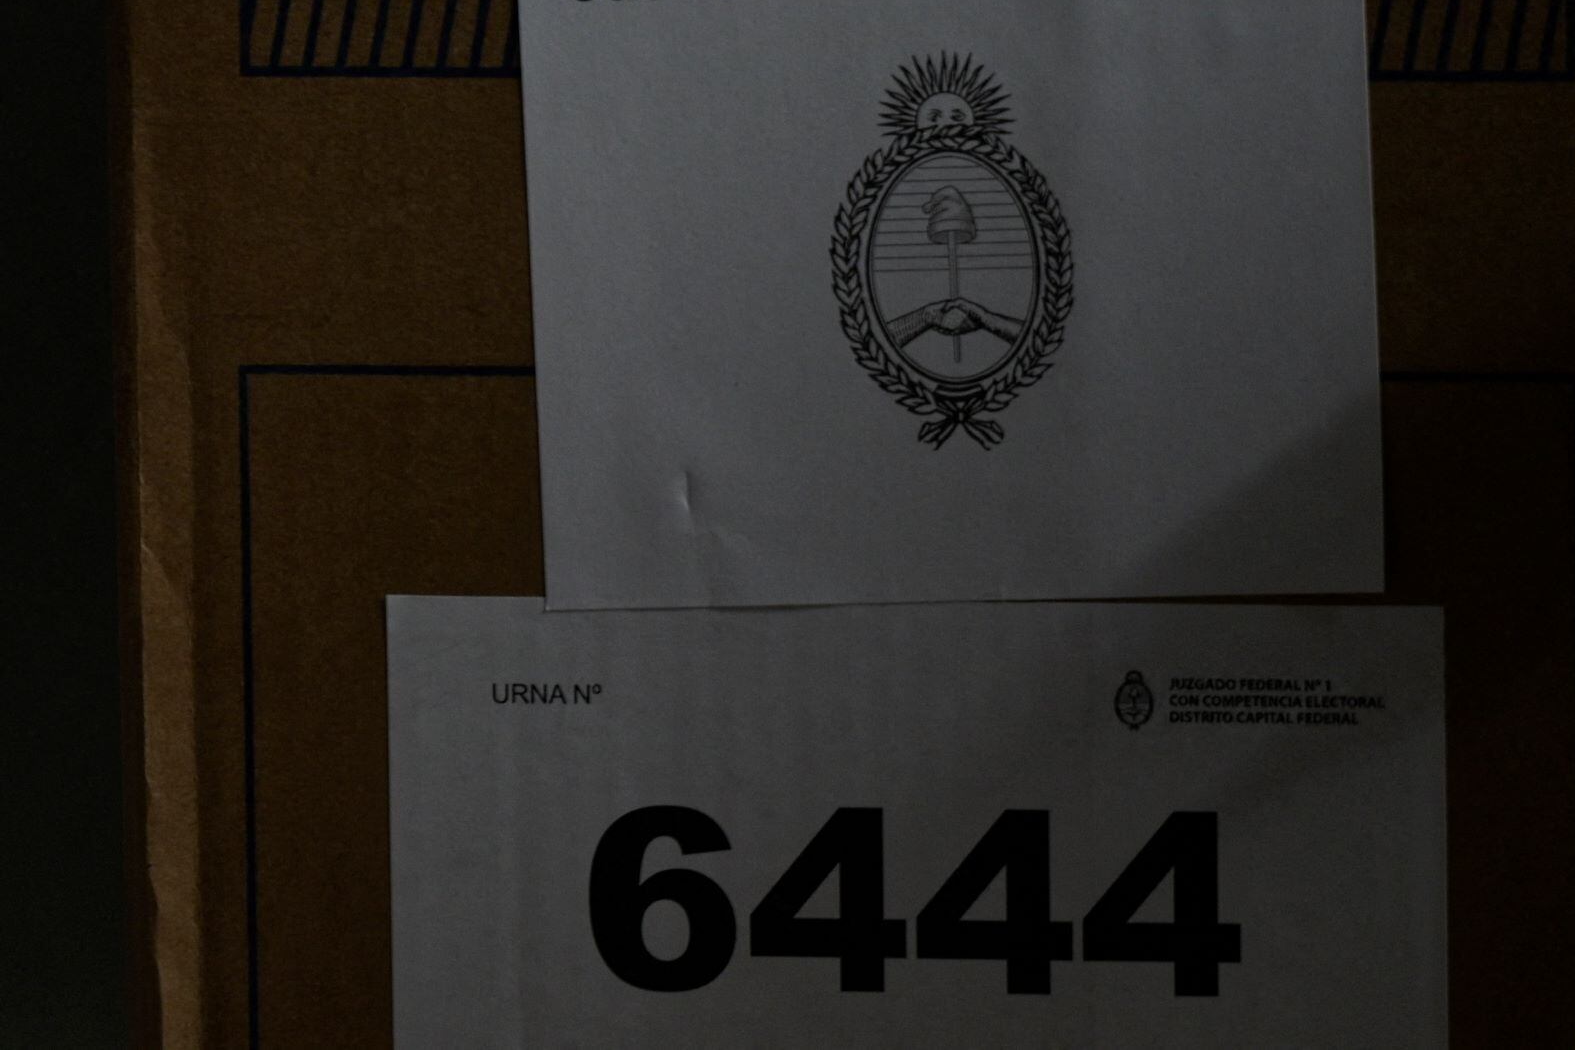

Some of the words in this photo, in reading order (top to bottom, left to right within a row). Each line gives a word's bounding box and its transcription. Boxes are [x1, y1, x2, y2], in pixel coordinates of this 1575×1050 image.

[1169, 678, 1236, 691] JUZGADO
[1239, 679, 1302, 692] FEDERAL
[492, 683, 567, 704] URNA
[1169, 695, 1200, 707] CON
[1202, 695, 1302, 708] COMPETENCIA
[1305, 696, 1387, 709] ELECTORAL
[1169, 711, 1234, 724] DISTRITO
[1235, 711, 1294, 724] CAPITAL
[1296, 712, 1359, 725] FEDERAL
[589, 805, 1242, 997] 6444
